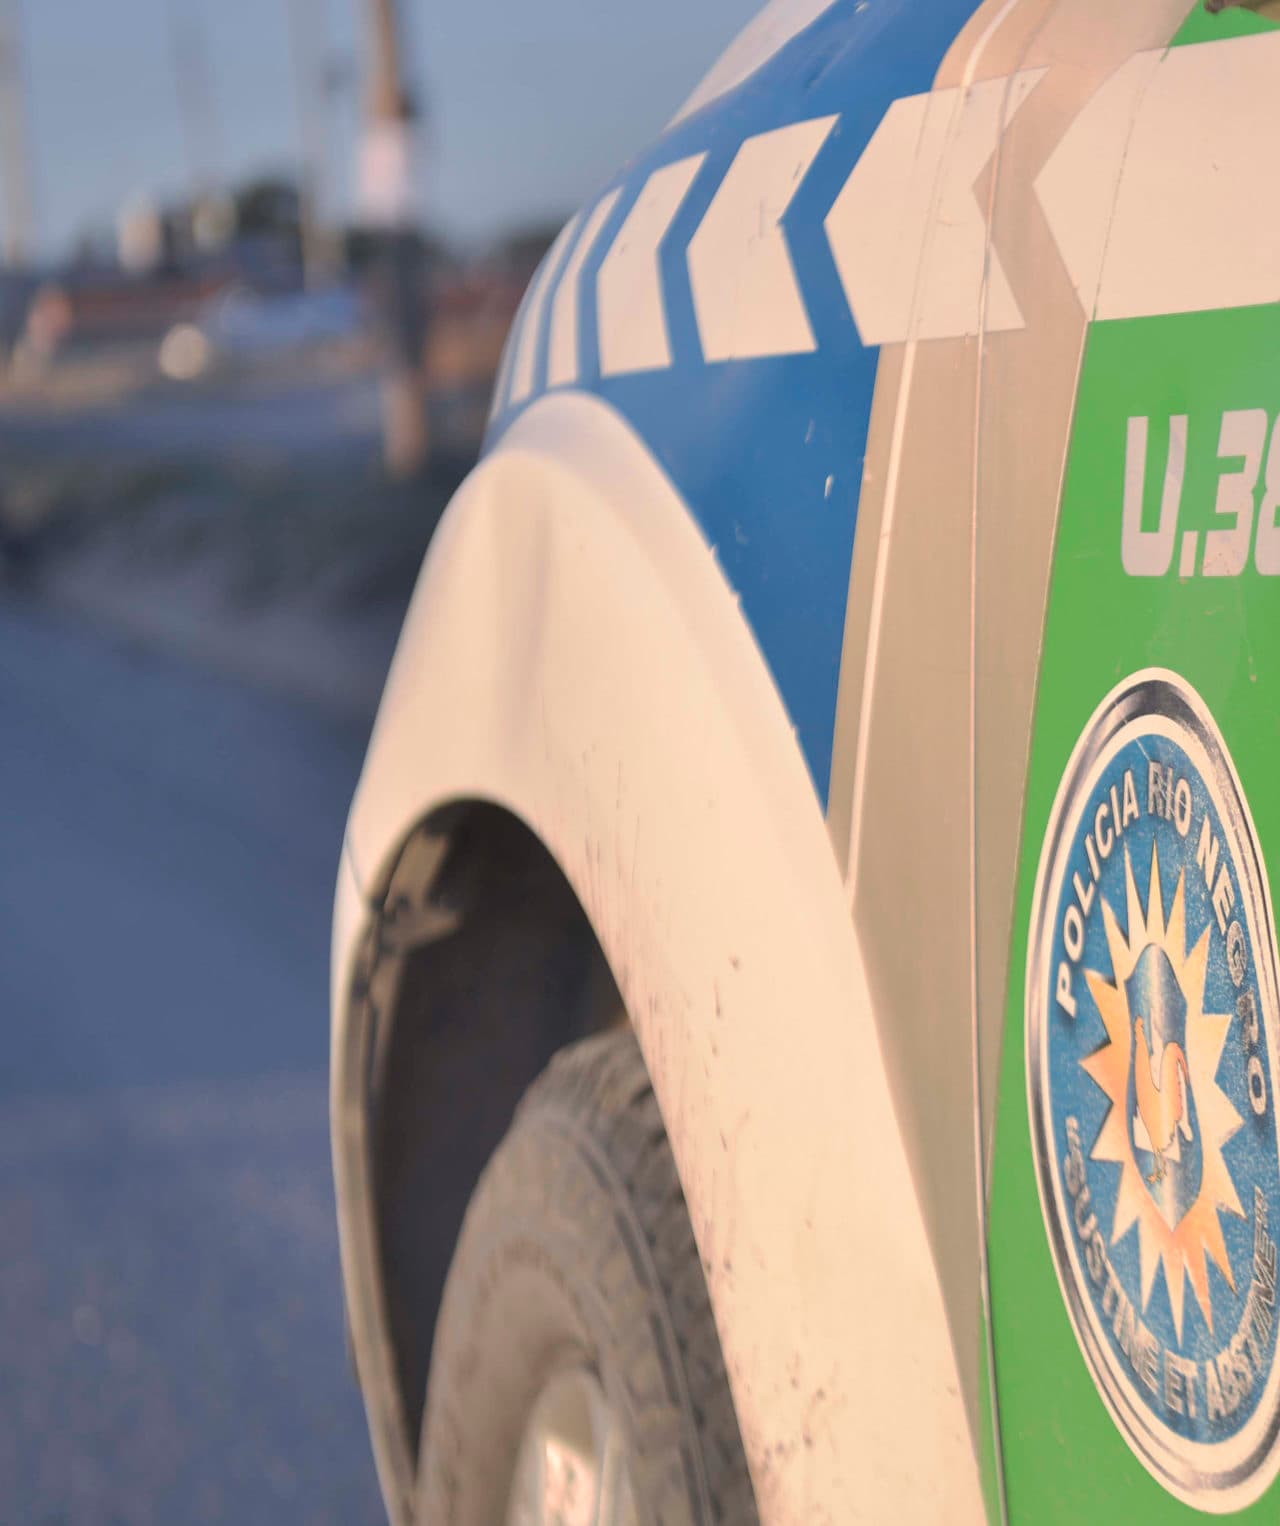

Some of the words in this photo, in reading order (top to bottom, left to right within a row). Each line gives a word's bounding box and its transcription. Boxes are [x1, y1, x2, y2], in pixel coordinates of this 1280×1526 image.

[1056, 768, 1140, 1017] POLICIA
[1147, 760, 1193, 839] RIO
[1163, 1348, 1199, 1418] ET
